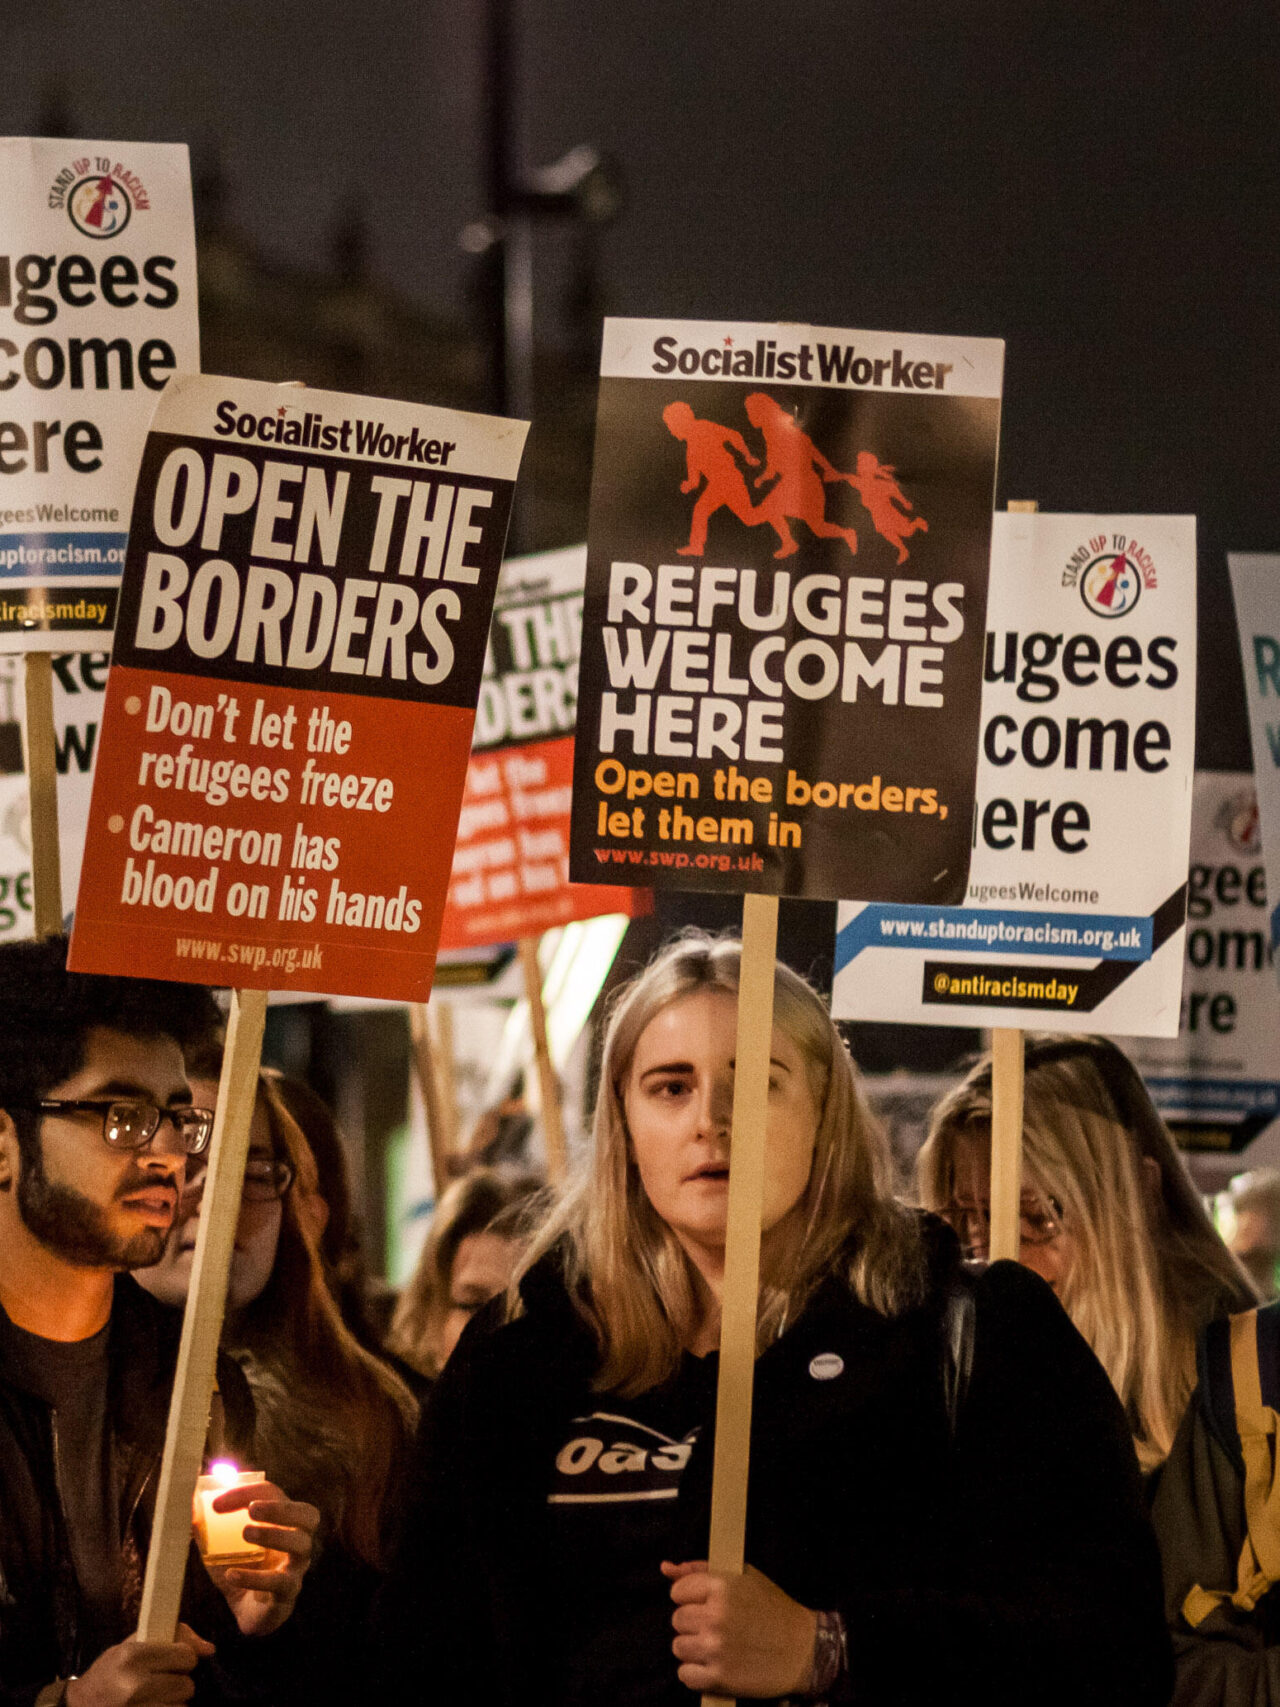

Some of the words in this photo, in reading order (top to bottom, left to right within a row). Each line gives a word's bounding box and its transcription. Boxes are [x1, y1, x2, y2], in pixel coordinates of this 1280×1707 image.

[73, 158, 90, 175] UP
[95, 157, 110, 172] TO
[112, 163, 150, 210] RACISM
[153, 446, 350, 567] OPEN
[368, 476, 493, 584] THE
[1089, 534, 1106, 553] UP
[1113, 534, 1126, 551] TO
[1127, 539, 1157, 590] RACISM
[135, 552, 462, 685] BORDERS
[606, 561, 965, 643] REFUGEES
[602, 627, 944, 707] WELCOME
[984, 630, 1178, 703] ugees
[146, 685, 240, 743] Don't
[250, 699, 297, 750] let
[306, 704, 352, 755] the
[599, 692, 785, 763] HERE
[984, 712, 1171, 774] come
[138, 744, 289, 806] refugees
[300, 760, 393, 812] freeze
[594, 759, 699, 801] Open
[713, 767, 773, 803] the
[787, 770, 948, 820] borders,
[129, 804, 281, 868] Cameron
[292, 823, 341, 872] has
[596, 803, 644, 838] let
[658, 806, 755, 845] them
[768, 813, 802, 848] in
[976, 797, 1091, 855] ere
[594, 848, 763, 873] www.swp.org.uk
[121, 858, 218, 913] blood
[227, 883, 269, 921] on
[279, 875, 317, 924] his
[326, 885, 422, 933] hands
[176, 936, 322, 974] www.swp.org.uk
[880, 917, 1141, 950] www.standuptoracism.org.uk
[934, 973, 1078, 1002] @antiracismday
[1187, 990, 1236, 1034] re
